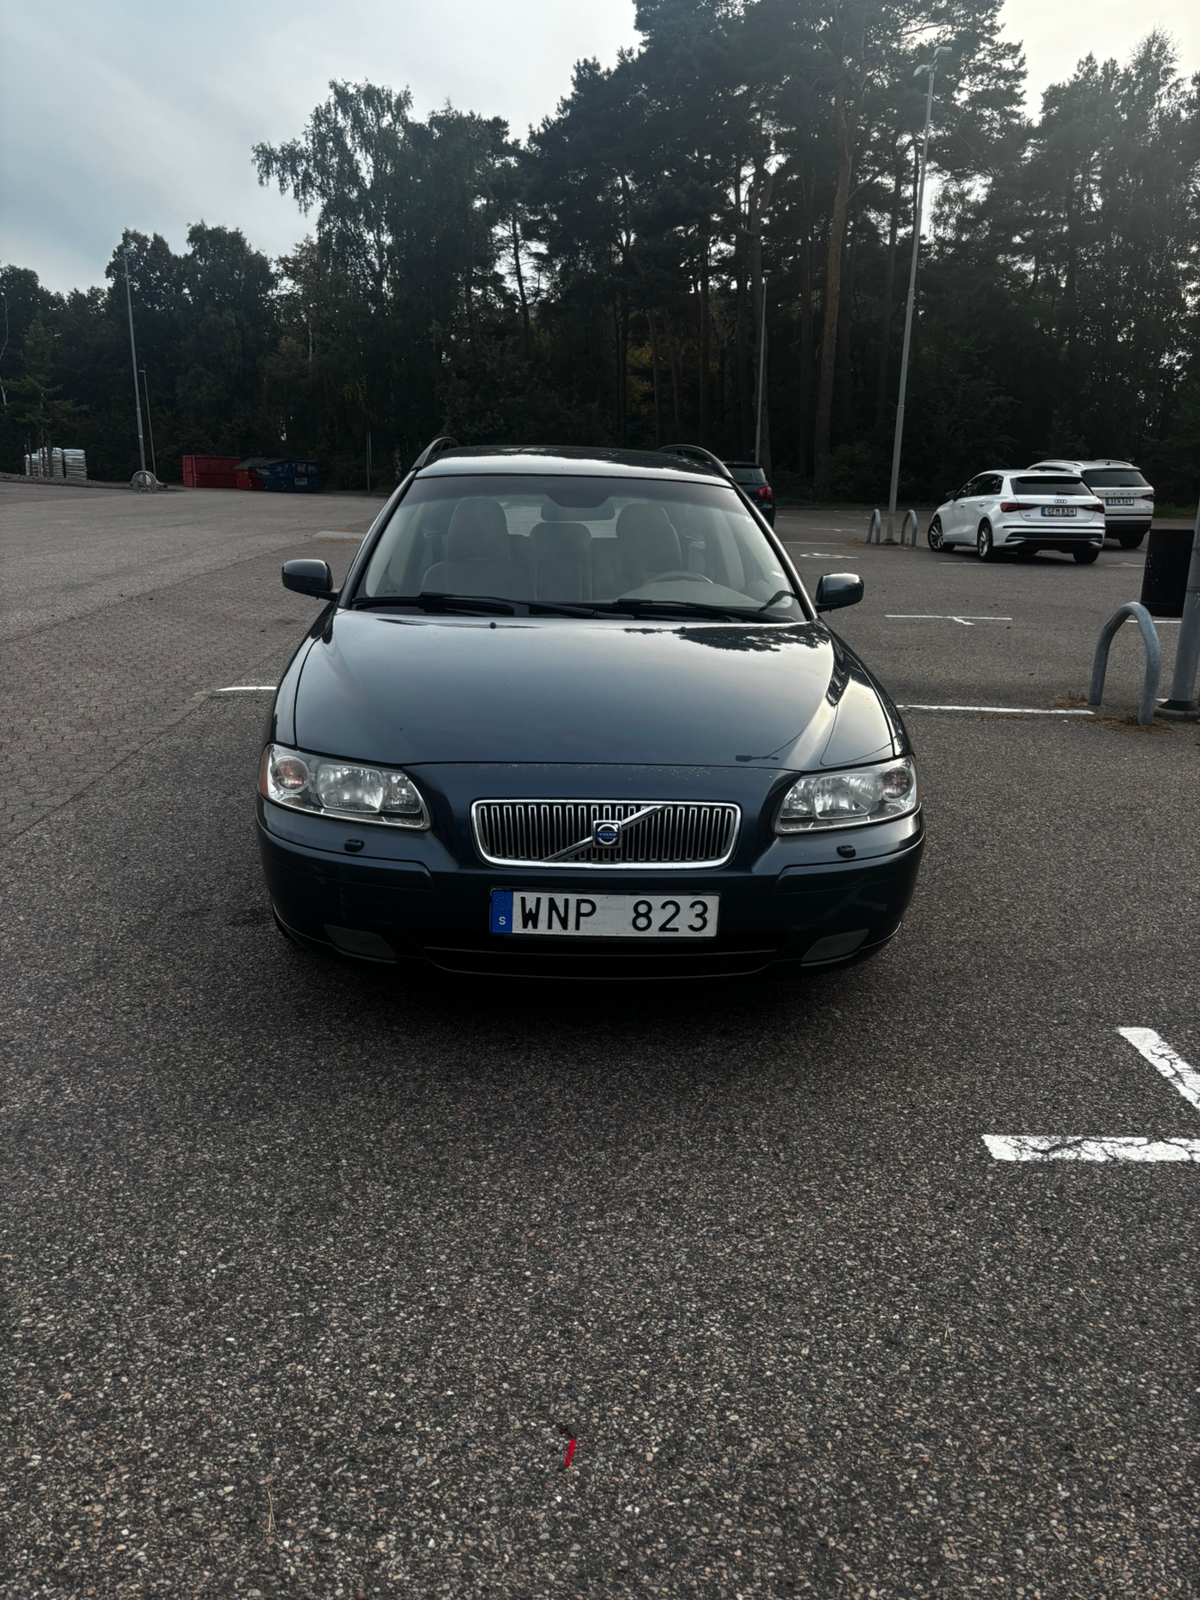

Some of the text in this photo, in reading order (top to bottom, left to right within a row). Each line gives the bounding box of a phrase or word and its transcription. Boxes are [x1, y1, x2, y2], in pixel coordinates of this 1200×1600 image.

[498, 916, 507, 926] S
[520, 896, 709, 932] WNP 823
